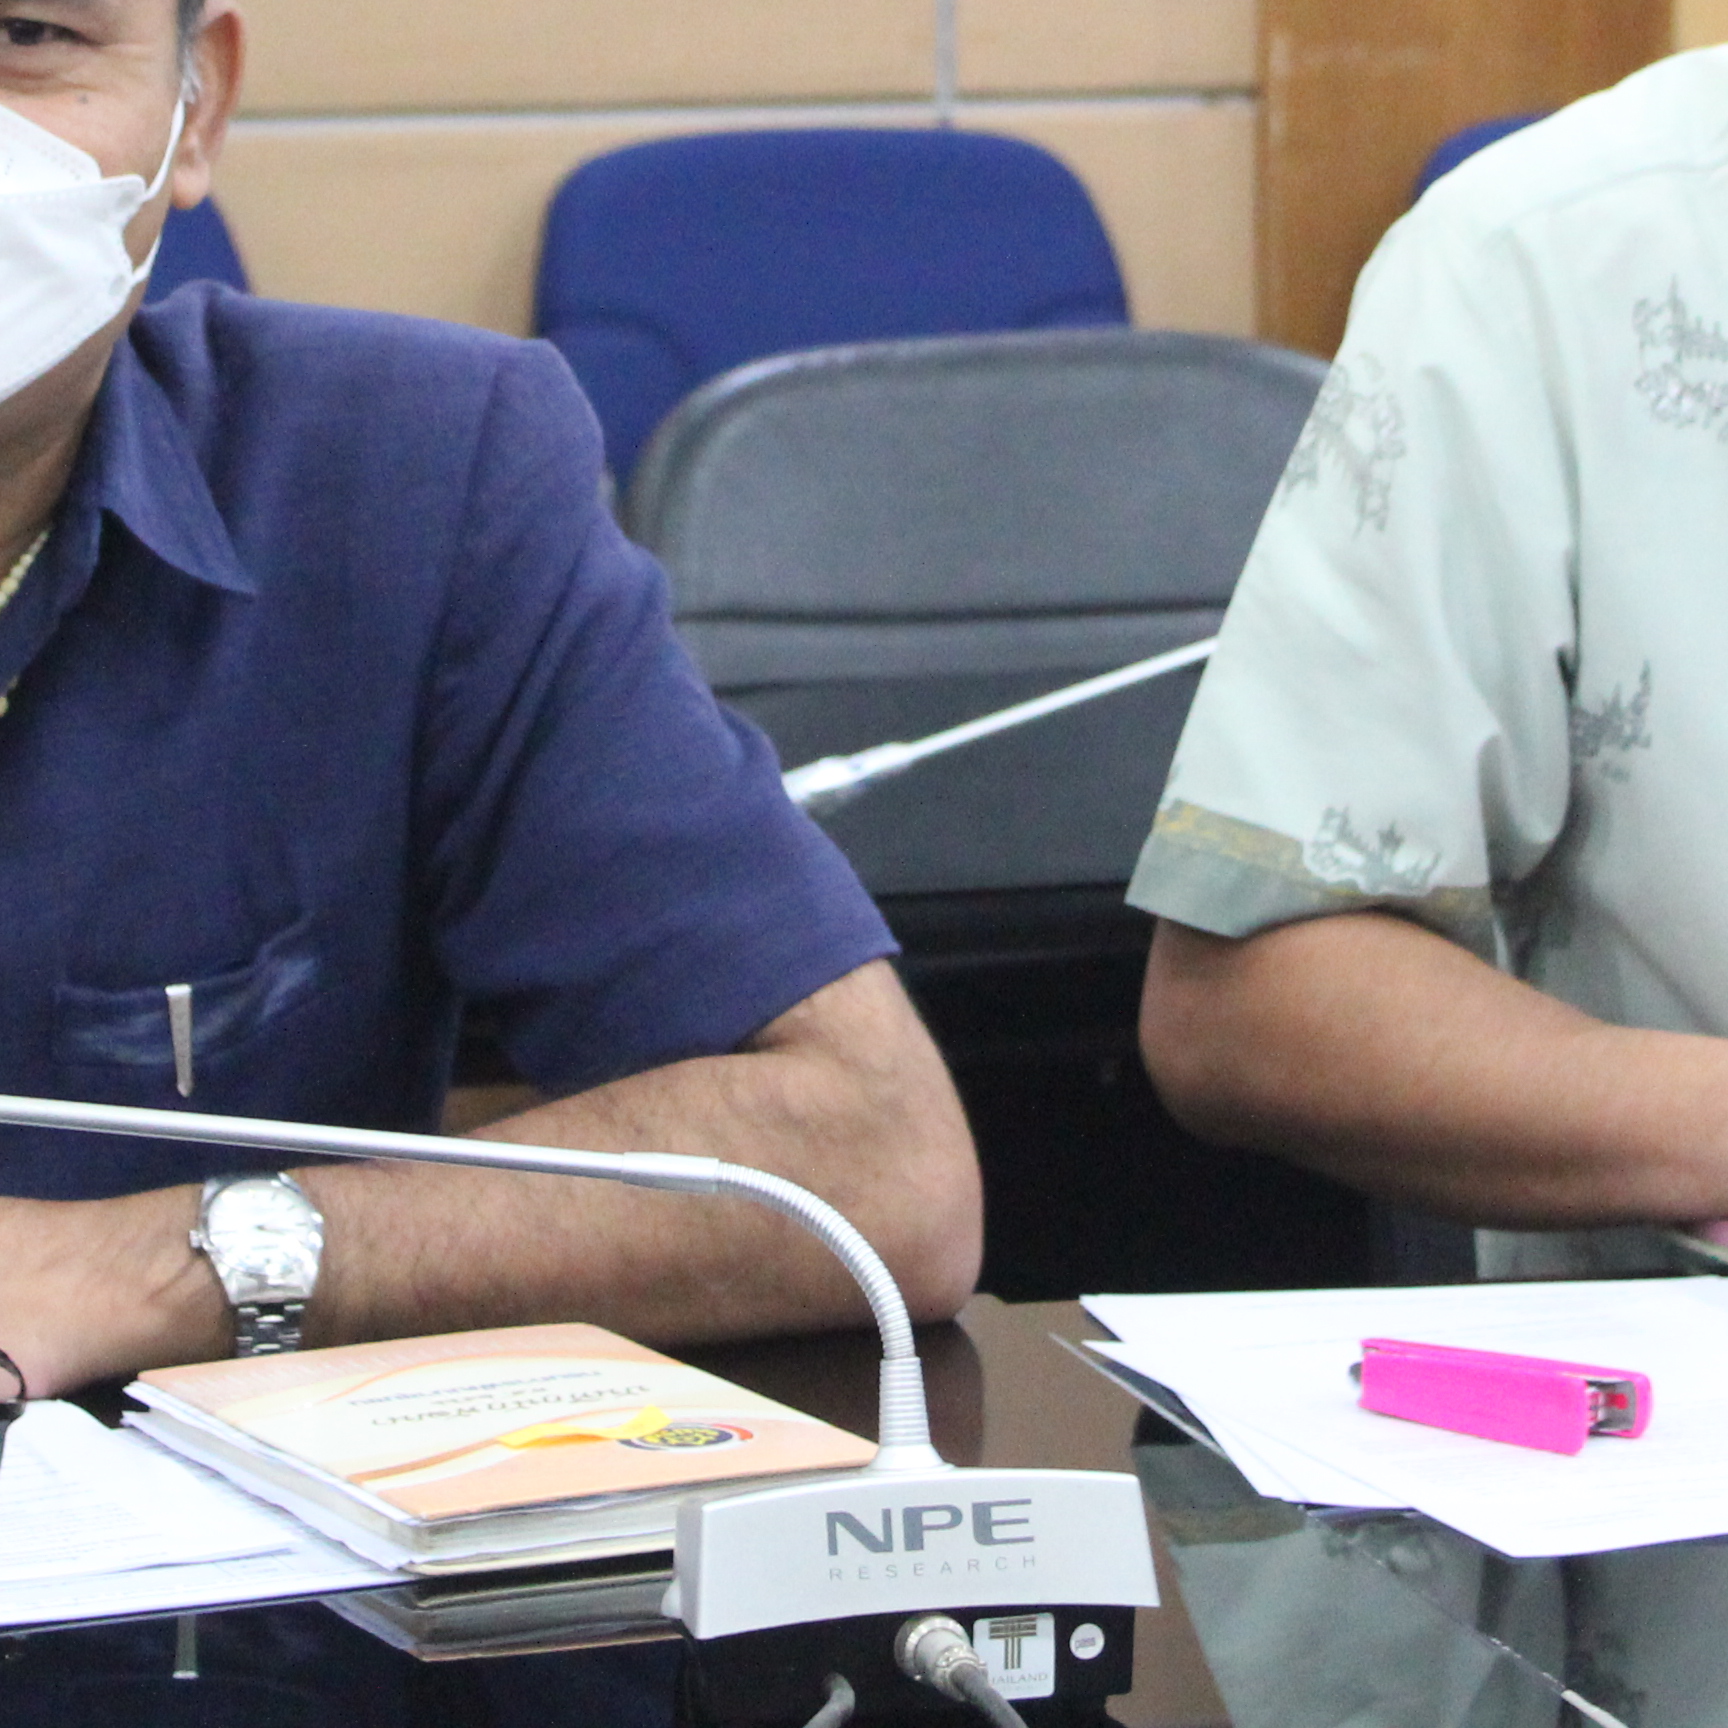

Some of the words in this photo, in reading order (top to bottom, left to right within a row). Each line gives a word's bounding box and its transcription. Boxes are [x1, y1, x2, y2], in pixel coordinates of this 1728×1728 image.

[826, 1498, 1034, 1555] NPE
[829, 1554, 1037, 1581] RESEARCH
[992, 1672, 1049, 1684] AILAND
